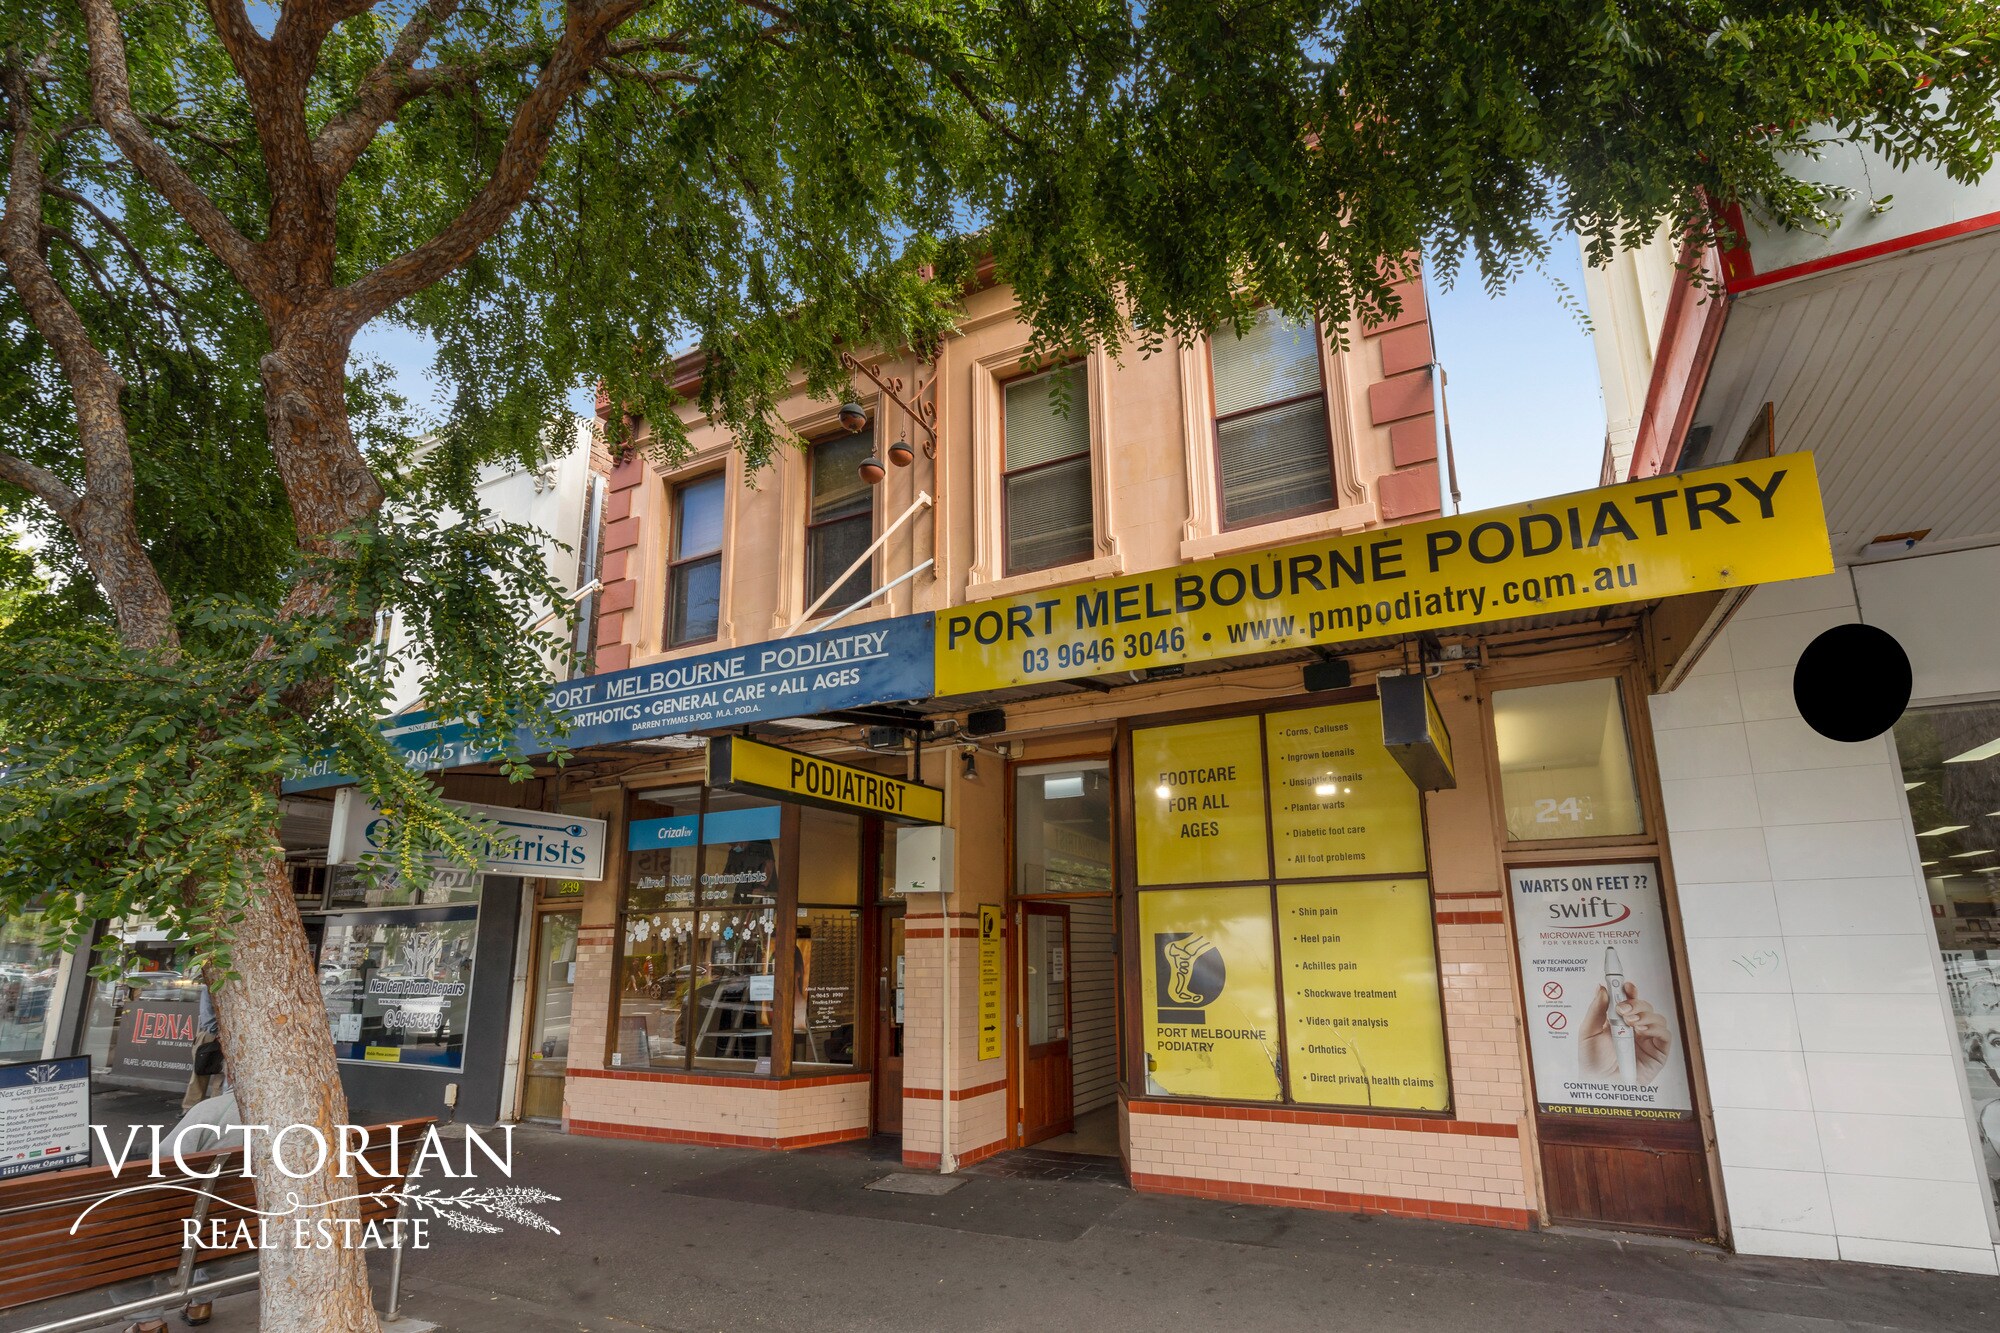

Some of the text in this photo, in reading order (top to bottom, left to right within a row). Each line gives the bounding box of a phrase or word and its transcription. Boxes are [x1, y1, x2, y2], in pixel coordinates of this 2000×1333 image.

[949, 470, 1788, 651] PORT MELBOURNE PODIATRY
[1023, 563, 1637, 674] 03 9646 3046 www.pmpodiatry.com.au
[545, 630, 889, 709] PORT MELBOURNE PODIATRY
[652, 691, 720, 716] GENERAL
[723, 682, 766, 704] CARE
[778, 676, 809, 695] ALL
[813, 668, 860, 691] AGES
[632, 719, 661, 731] DARREN
[662, 715, 689, 726] TYMMS
[1286, 723, 1349, 737] Corns, Calluses
[404, 743, 455, 767] 9645
[1288, 748, 1355, 763] Ingrown toenails
[1160, 766, 1236, 786] FOOTCARE
[1289, 776, 1327, 788] Unsightly
[791, 757, 906, 812] PODIATRIST
[1168, 794, 1229, 812] FOR ALL
[1291, 801, 1344, 812] Plantar warts
[1181, 821, 1219, 838] AGES
[1293, 826, 1365, 838] Diabetic foot care
[365, 818, 587, 864] Otrists
[1294, 852, 1365, 863] All foot problems
[636, 876, 666, 889] Alfred
[700, 870, 767, 888] Optometrists
[1519, 875, 1648, 893] WARTS ON FEET ??
[561, 881, 580, 894] 239
[1299, 907, 1338, 917] Shin pain
[1549, 896, 1617, 919] swift
[1300, 934, 1340, 944] Heel pain
[1540, 930, 1641, 940] MICROWAVE THERAPY
[1302, 961, 1357, 972] Achilles pain
[369, 978, 465, 997] Nex Gen Phone Repairs
[1304, 988, 1397, 998] Shockwave treatment
[131, 1009, 194, 1044] LEBNA
[1306, 1017, 1388, 1029] Video gait analysis
[1157, 1028, 1267, 1040] PORT MELBOURNE
[1157, 1041, 1215, 1052] PODIATRY
[1308, 1045, 1346, 1054] Orthotics
[1310, 1073, 1434, 1087] Direct private health claims
[33, 1085, 57, 1094] Phone
[59, 1081, 86, 1092] Repairs
[1563, 1082, 1659, 1093] CONTINUE YOUR DAY
[1570, 1091, 1655, 1102] WITH CONFIDENCE
[48, 1112, 78, 1120] Unlocking
[1549, 1105, 1681, 1119] PORT MELBOURNE PODIATRY
[52, 1123, 85, 1131] Accessories
[26, 1134, 51, 1142] Damage
[6, 1140, 52, 1152] Friendly Advice
[20, 1159, 64, 1172] Now Open
